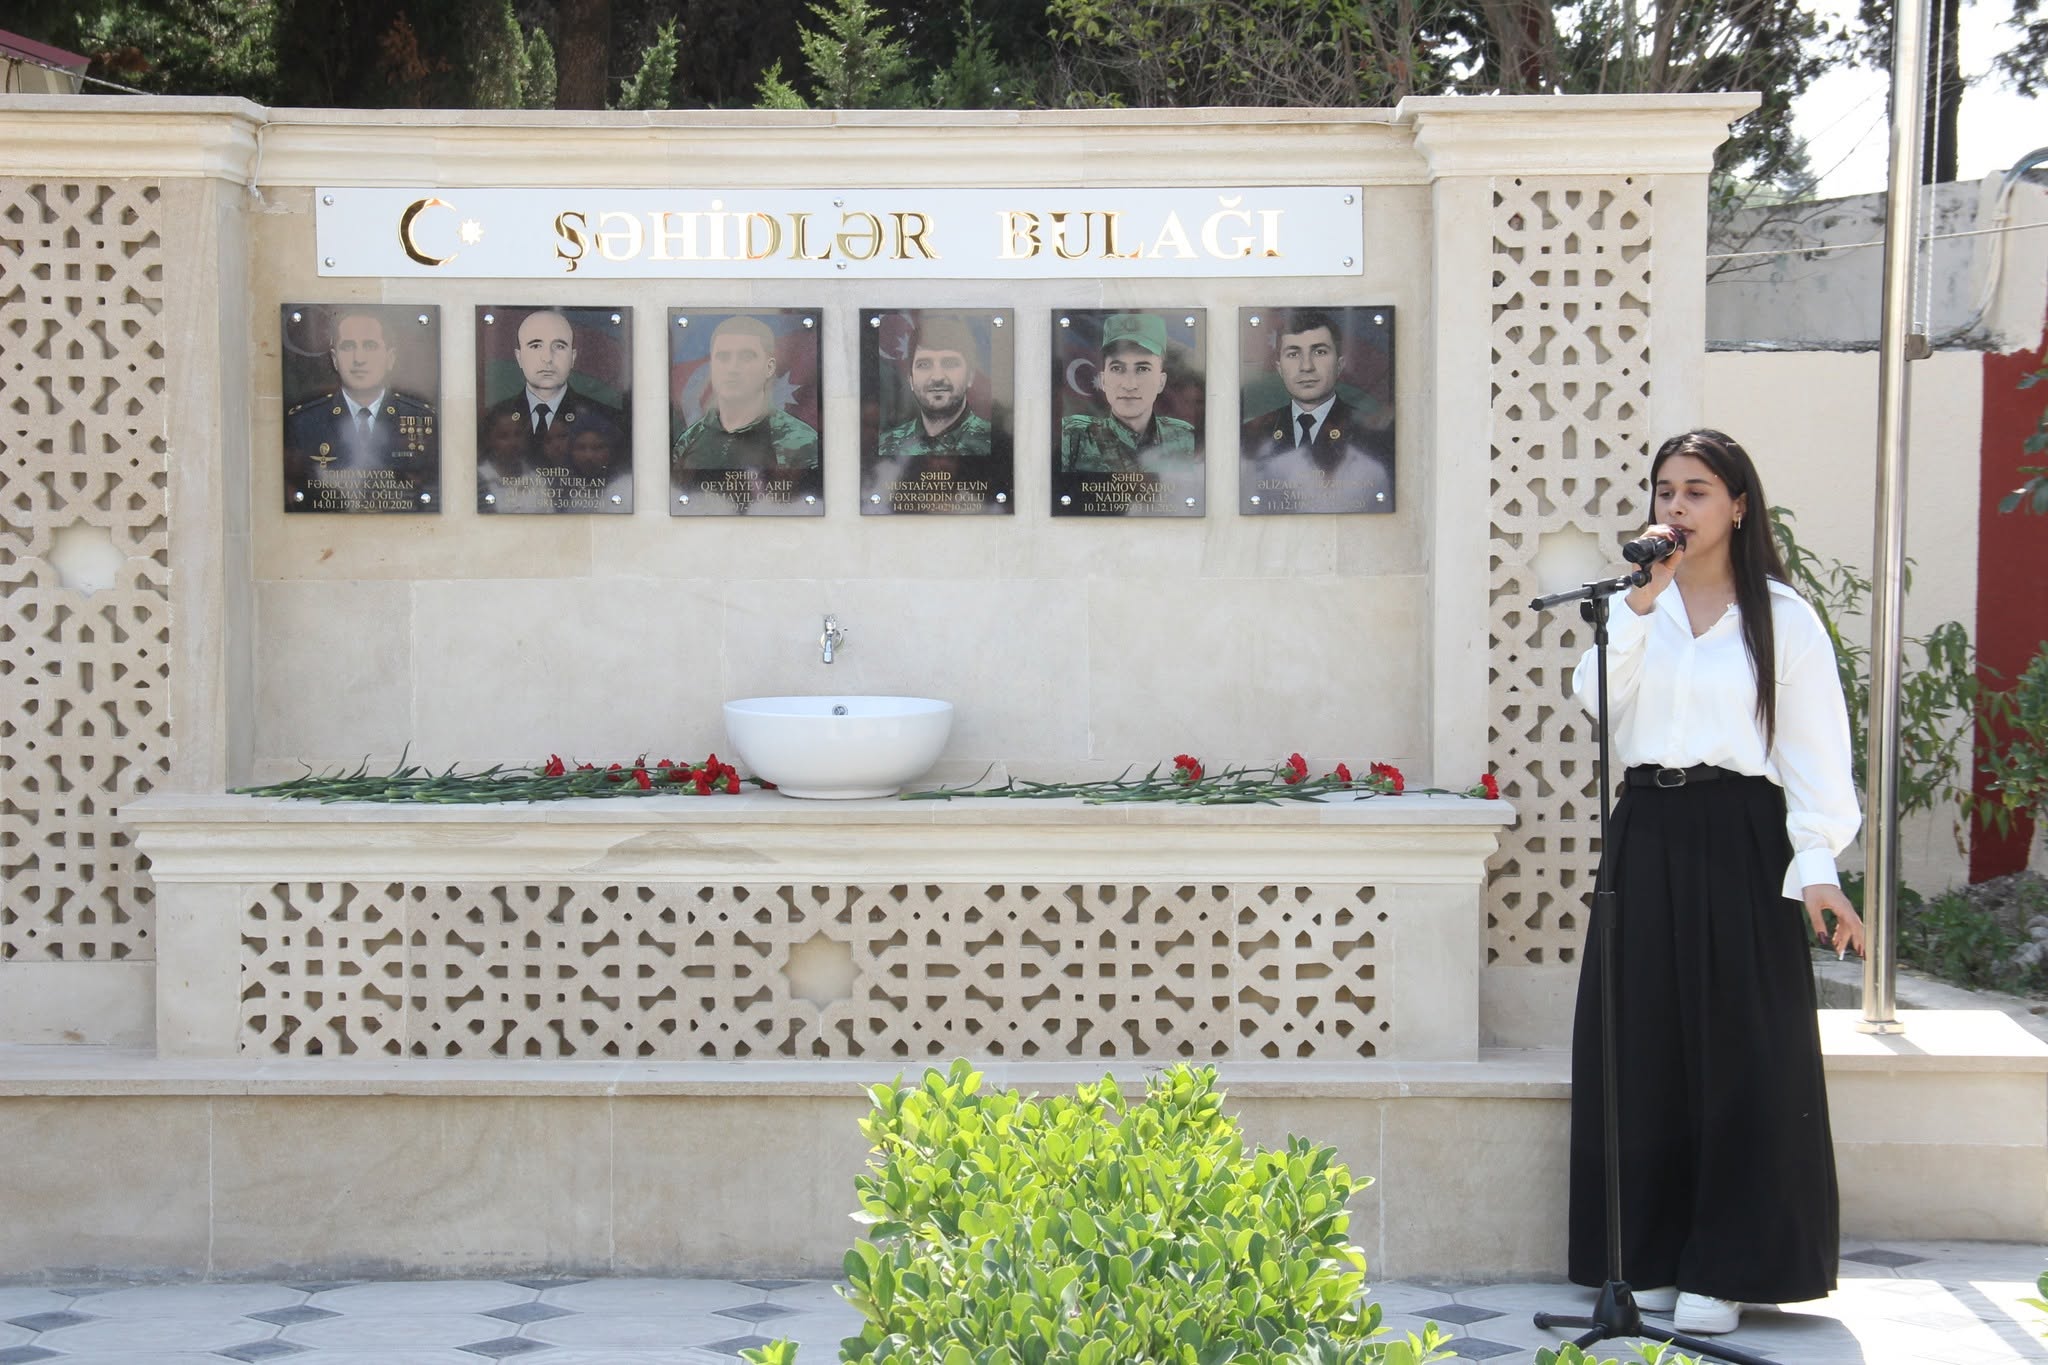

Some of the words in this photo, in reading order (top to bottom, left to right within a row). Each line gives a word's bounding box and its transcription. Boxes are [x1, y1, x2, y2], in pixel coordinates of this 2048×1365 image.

[553, 199, 942, 272] ŞƏHİDLƏR
[994, 196, 1286, 260] BULAĞI
[535, 466, 570, 478] ŞƏHİD
[920, 471, 951, 482] ŞƏHİD
[1111, 472, 1144, 483] ŞƏHİD
[363, 480, 414, 489] KAMRAN
[559, 477, 606, 487] NURLAN
[765, 479, 793, 491] ARİF
[957, 480, 988, 490] ELVİN
[1081, 481, 1137, 492] RƏHİMOV
[372, 489, 403, 499] OĞLU
[1095, 491, 1132, 502] NADİR
[313, 500, 413, 510] 14.01.1978-20.10.2020
